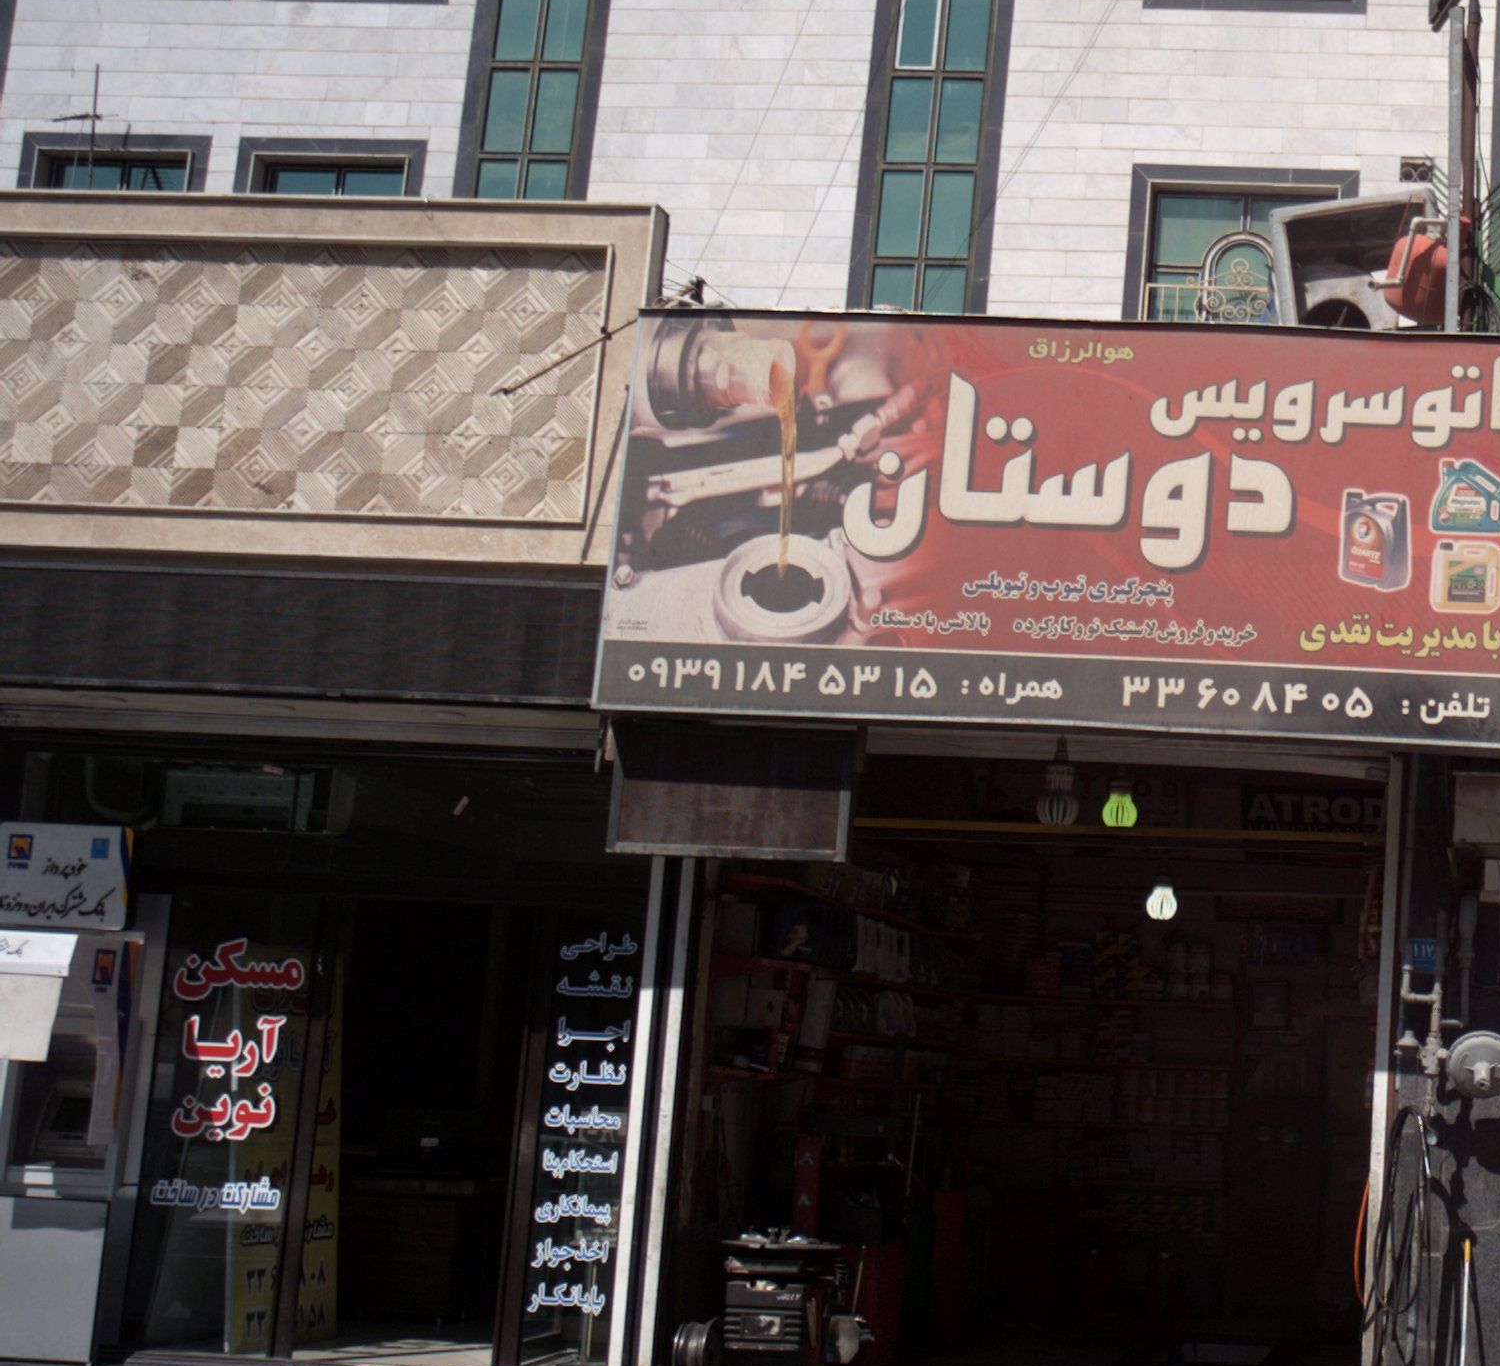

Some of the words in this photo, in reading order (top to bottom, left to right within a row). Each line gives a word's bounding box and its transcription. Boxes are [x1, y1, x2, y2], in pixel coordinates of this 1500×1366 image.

[843, 372, 1297, 569] دوستان
[1041, 575, 1087, 602] تیوب
[1088, 577, 1175, 607] پنچرگیری
[871, 609, 923, 628] دستگاه
[922, 610, 938, 634] با
[938, 611, 991, 636] بالانس
[1103, 619, 1158, 640] لاستیک
[1299, 613, 1372, 652] نقدی
[1375, 622, 1478, 657] مدیریت
[1481, 619, 1500, 659] با
[58, 883, 87, 920] مشترک
[78, 887, 117, 922] بانک
[560, 931, 638, 961] طراحی
[174, 937, 305, 1001] مسکن
[556, 969, 634, 998] نقشه
[183, 1014, 287, 1078] آریا
[557, 1016, 631, 1053] اجرا
[549, 1060, 627, 1091] نظارت
[172, 1082, 276, 1141] نوین
[544, 1103, 622, 1135] محاسبات
[150, 1177, 198, 1205] ساخت
[197, 1188, 218, 1210] در
[219, 1176, 281, 1214] مشارکت
[534, 1194, 612, 1226] پیمانکاری
